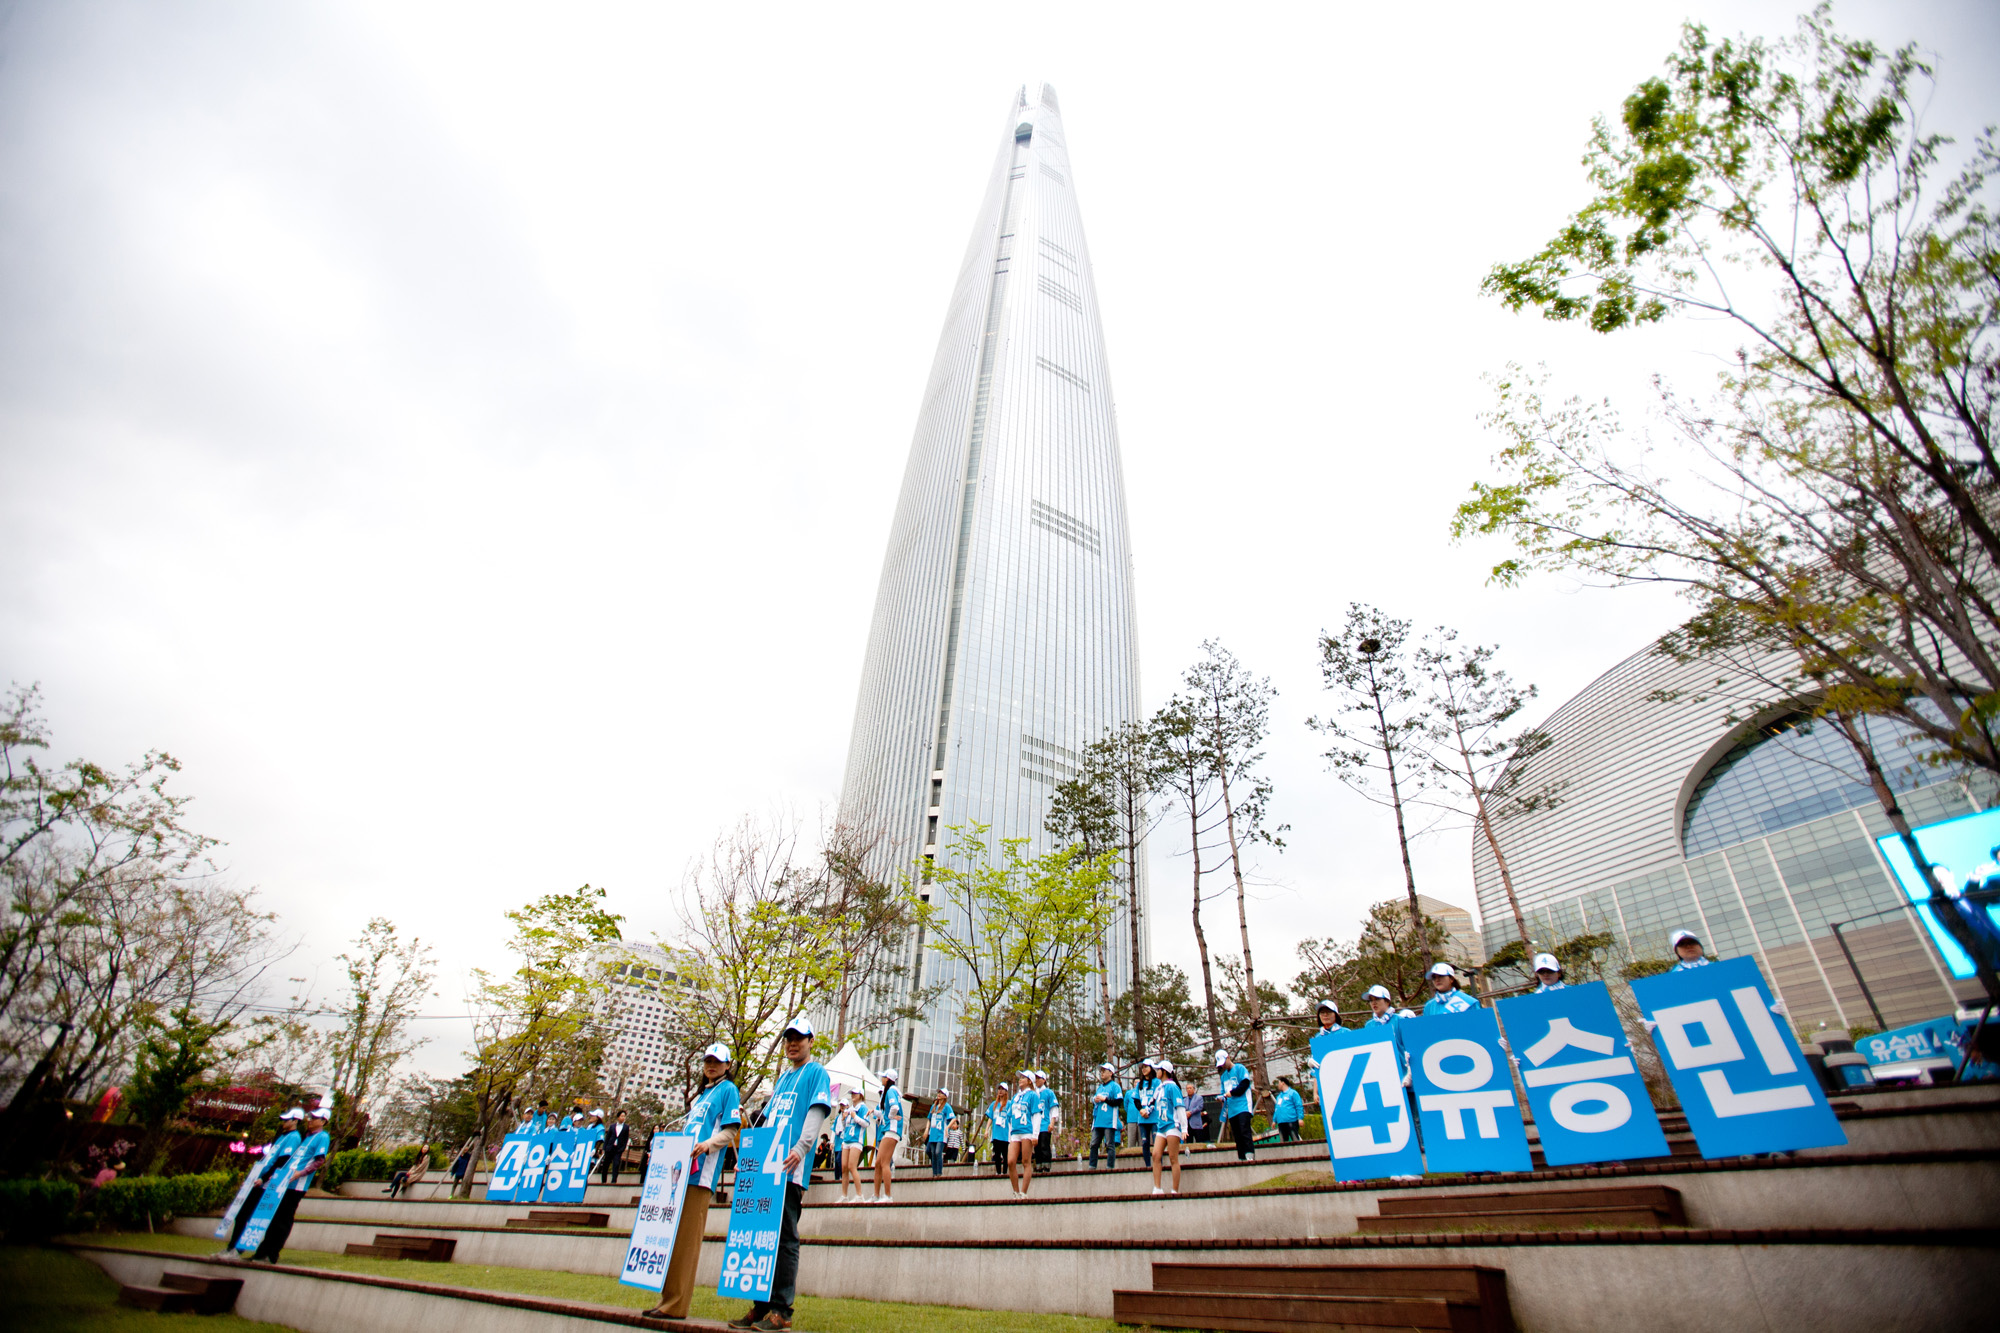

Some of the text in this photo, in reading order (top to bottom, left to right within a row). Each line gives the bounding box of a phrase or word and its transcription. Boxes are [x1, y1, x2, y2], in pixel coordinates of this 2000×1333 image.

[1869, 1032, 1932, 1062] 유승민
[1101, 1102, 1108, 1112] 4
[936, 1121, 942, 1130] 4
[1020, 1114, 1027, 1125] 4
[849, 1126, 855, 1137] 4
[762, 1125, 786, 1186] 4
[649, 1162, 668, 1180] 안보는
[740, 1157, 760, 1173] 안보는
[644, 1183, 662, 1201] 보수!
[738, 1180, 755, 1194] 보수!
[640, 1204, 677, 1225] 민생은 개혁!
[735, 1197, 773, 1215] 민생은 개혁!
[728, 1229, 778, 1251] 보수의 새희망
[722, 1251, 774, 1293] 유승민
